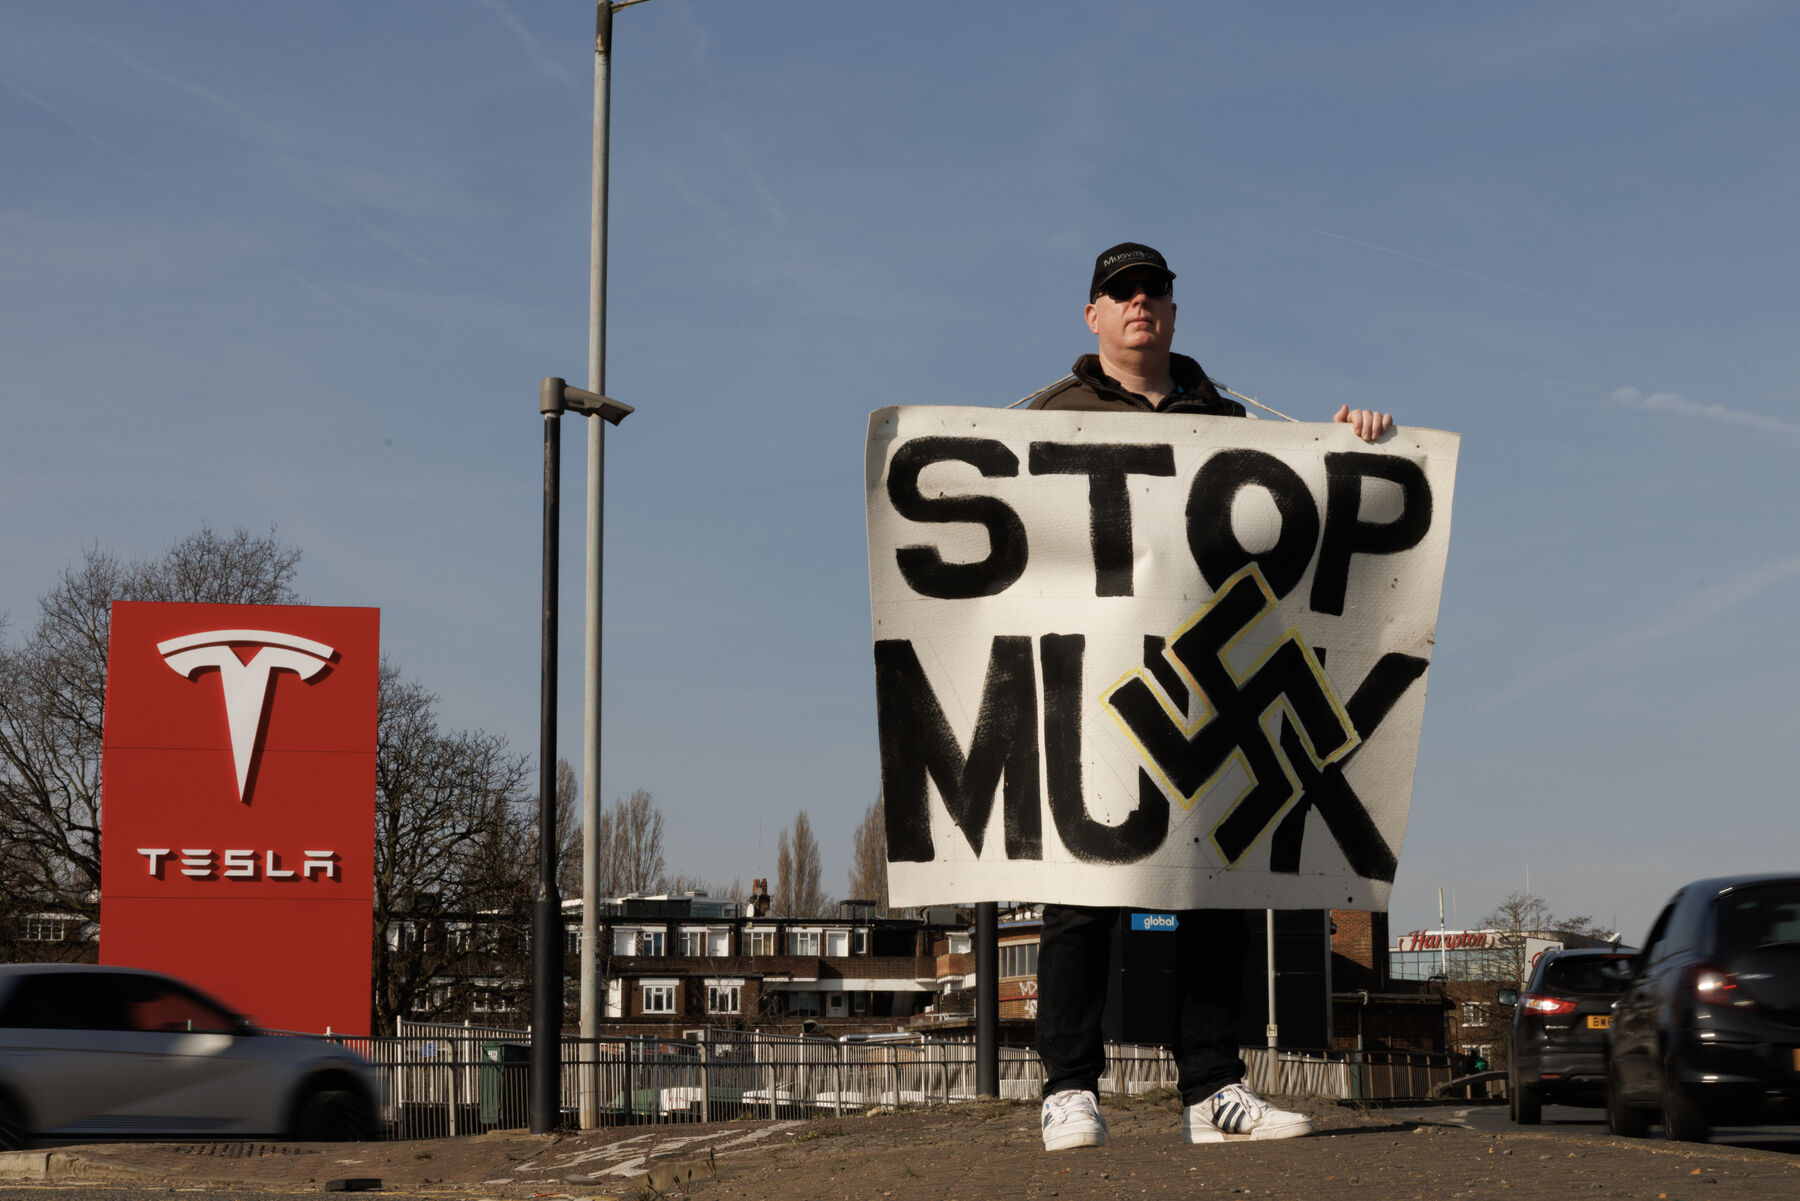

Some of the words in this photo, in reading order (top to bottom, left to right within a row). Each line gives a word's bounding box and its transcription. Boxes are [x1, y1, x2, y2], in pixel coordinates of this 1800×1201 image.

[887, 435, 1433, 616] STOP
[874, 632, 1430, 884] MUK
[137, 848, 335, 877] TESLA
[1144, 915, 1174, 929] global
[1408, 929, 1487, 951] Hampton
